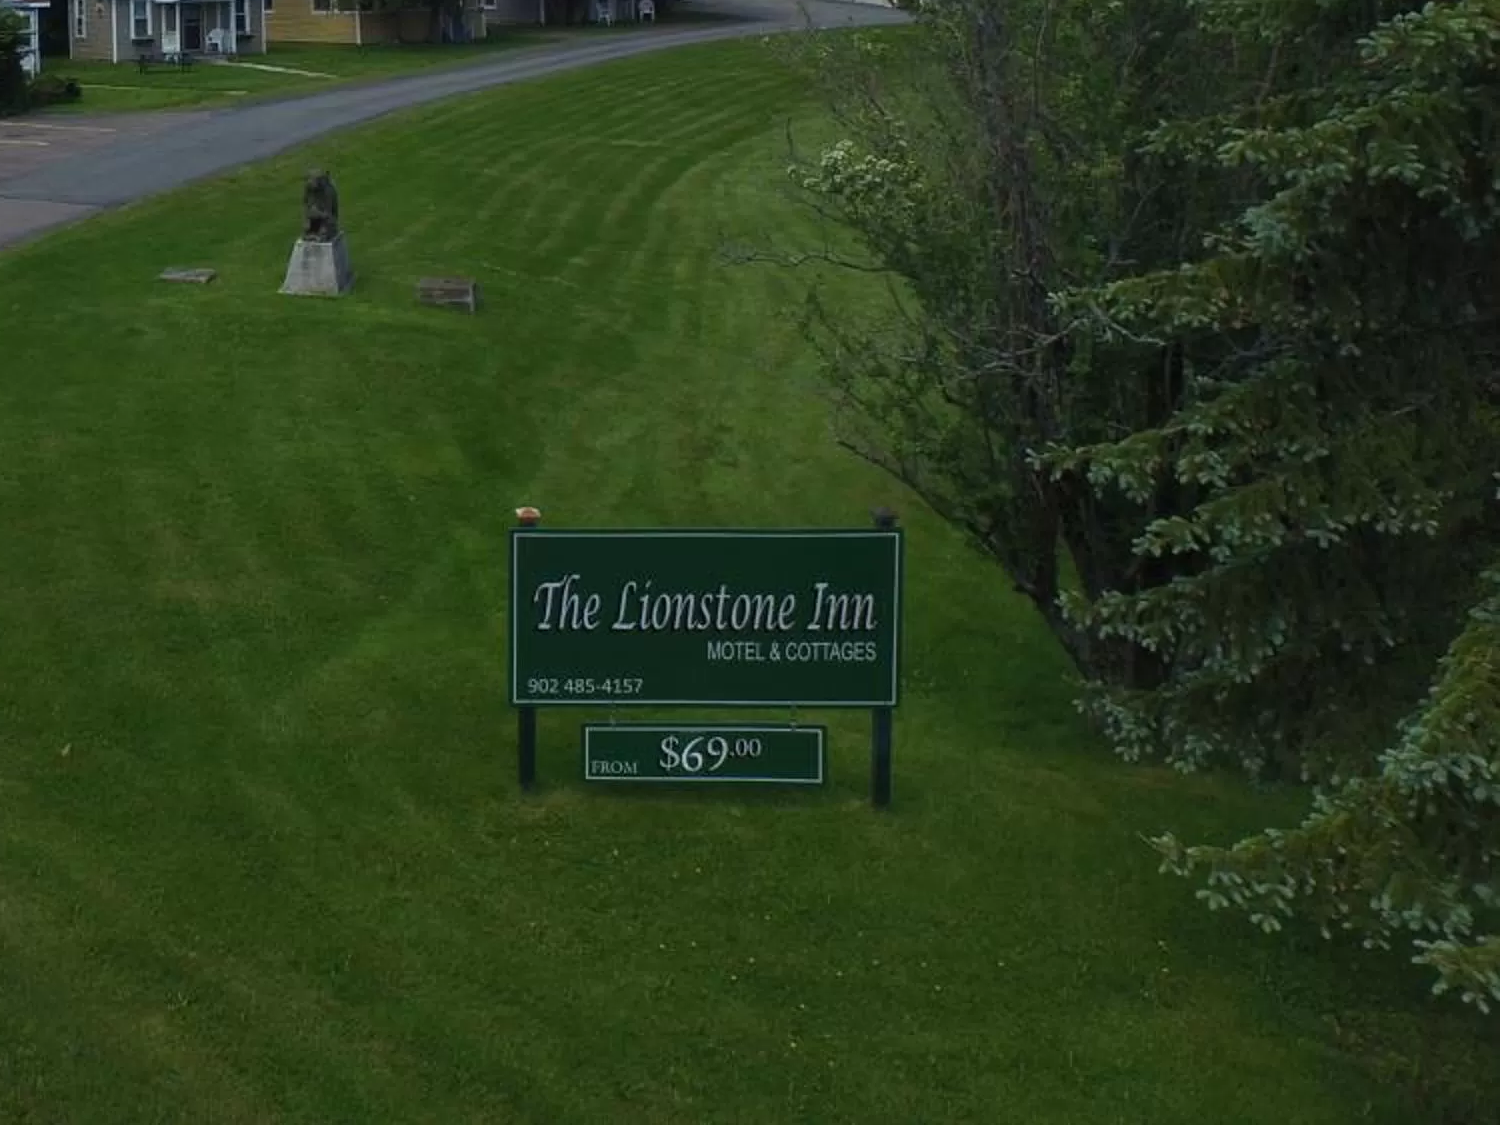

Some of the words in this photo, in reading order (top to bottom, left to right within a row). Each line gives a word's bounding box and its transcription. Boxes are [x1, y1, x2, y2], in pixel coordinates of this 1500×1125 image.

[534, 574, 600, 630] The
[612, 579, 796, 631] Lionstone
[807, 582, 877, 631] Inn
[707, 641, 765, 661] MOTEL
[769, 642, 781, 661] &
[785, 641, 877, 661] COTTAGES
[527, 678, 559, 694] 902
[563, 678, 643, 695] 485-4157
[591, 760, 638, 775] FROM
